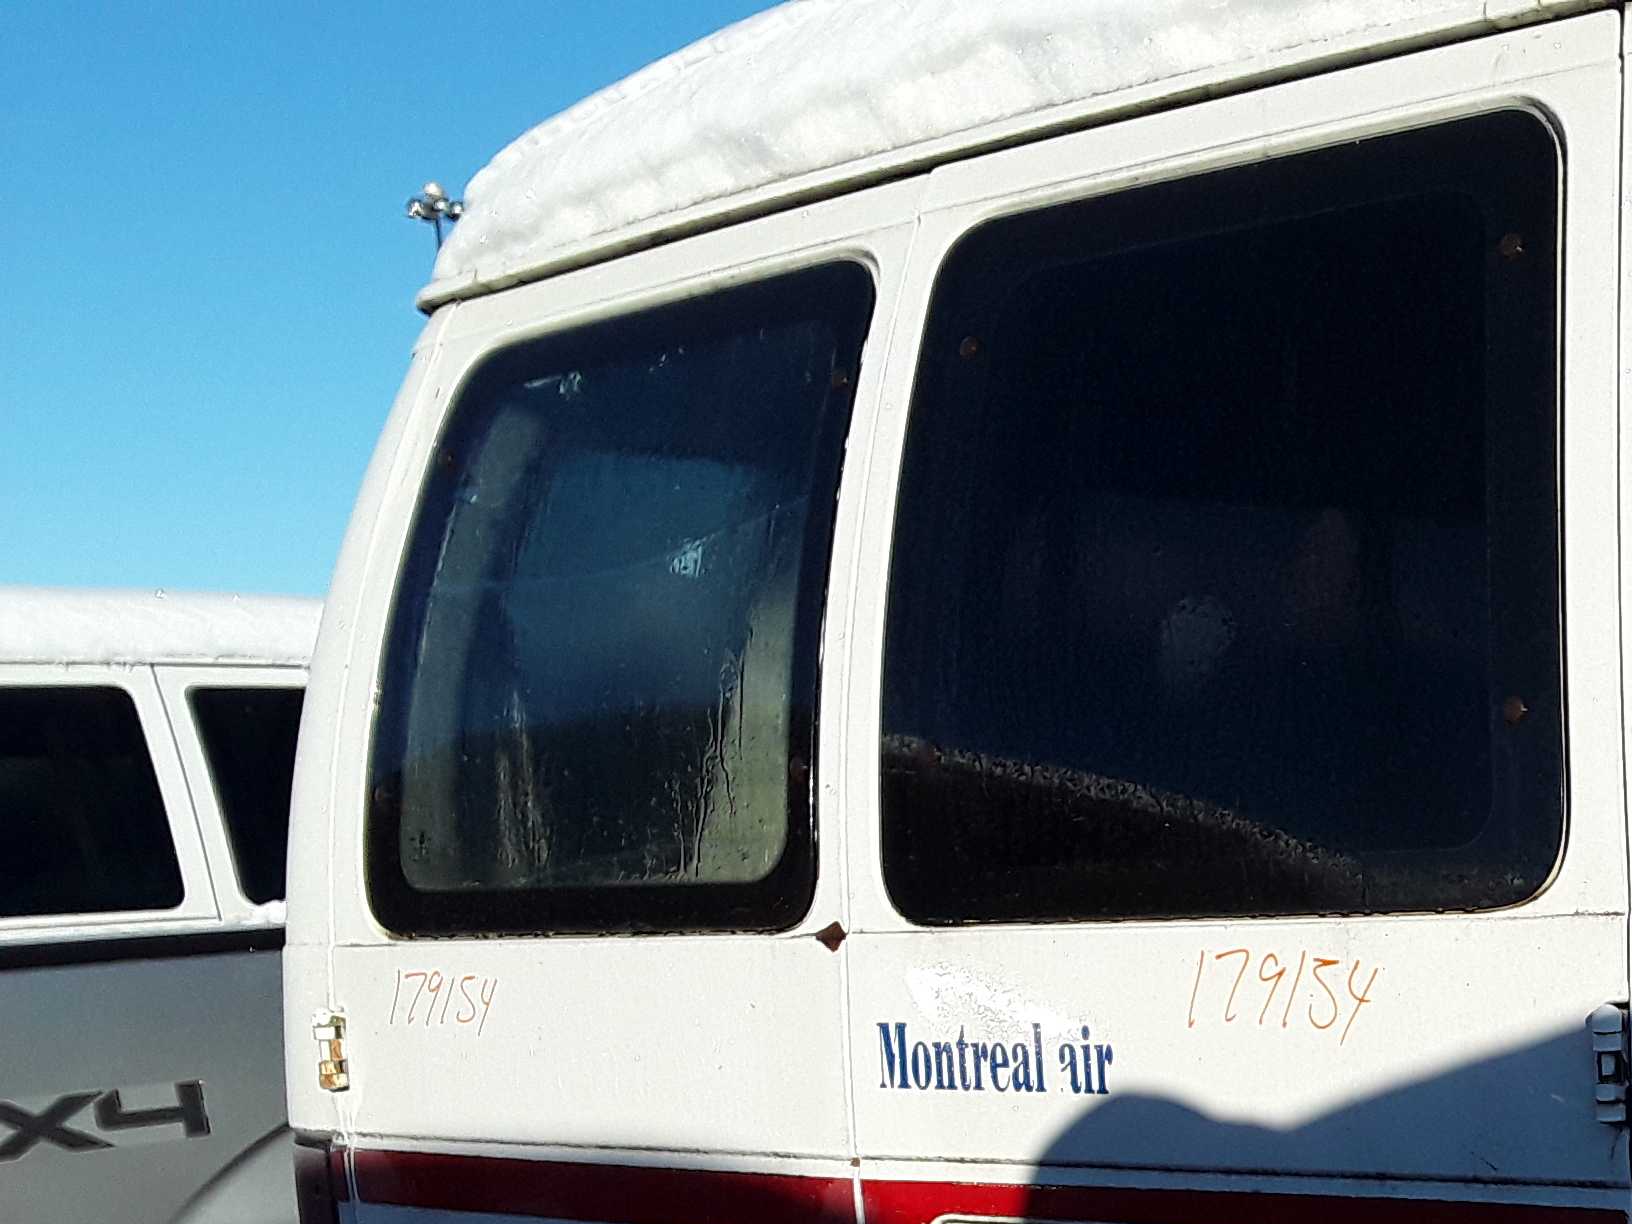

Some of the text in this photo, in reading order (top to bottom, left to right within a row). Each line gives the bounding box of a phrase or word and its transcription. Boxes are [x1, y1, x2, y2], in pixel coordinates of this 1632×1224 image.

[388, 967, 499, 1037] 179154
[1187, 948, 1379, 1047] 179154
[875, 1021, 1114, 1095] Montreal air
